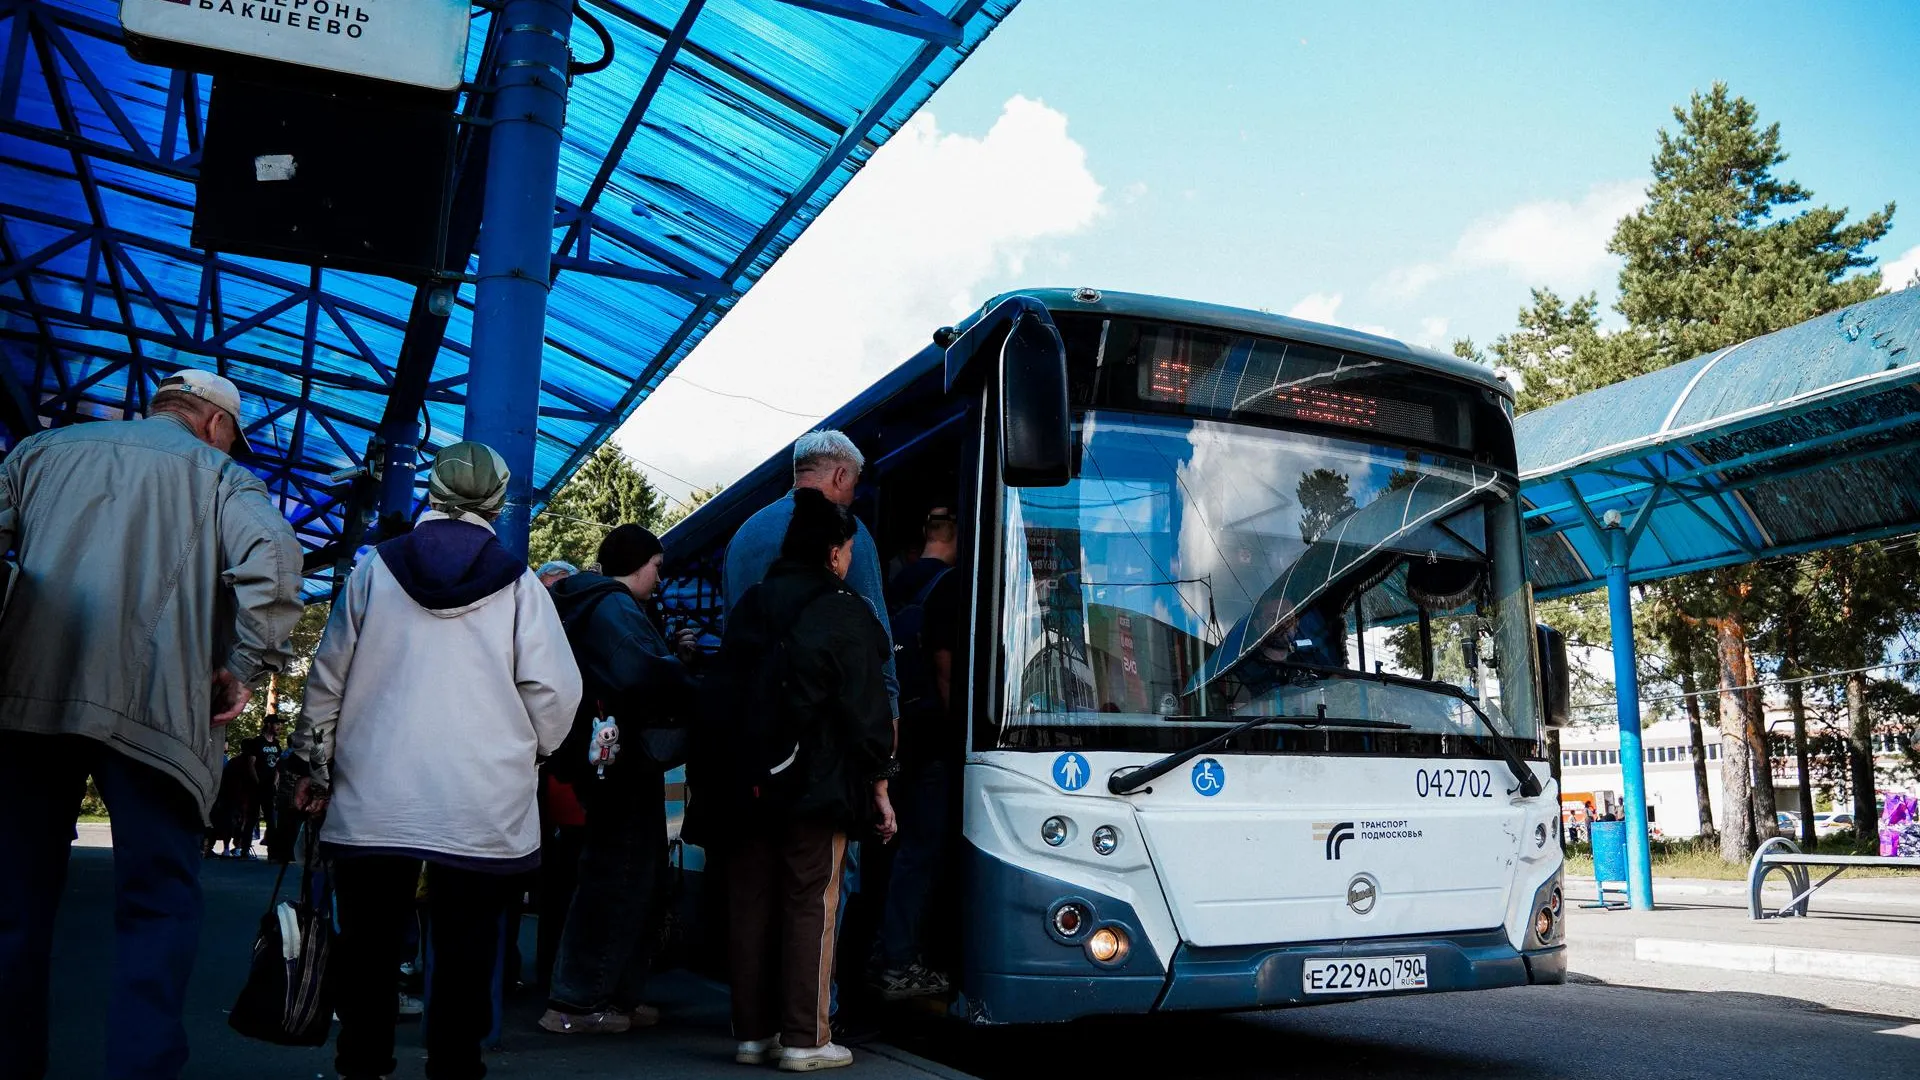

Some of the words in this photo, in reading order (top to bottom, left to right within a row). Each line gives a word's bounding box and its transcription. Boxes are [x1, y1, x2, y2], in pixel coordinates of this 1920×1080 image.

[199, 0, 362, 38] БАКШЕЕВО
[254, 0, 370, 22] РОНЬ
[1416, 768, 1493, 798] 042702
[1360, 820, 1408, 829] ТРАНСПОРТ
[1361, 830, 1423, 840] ПОДМОСКОВЬЯ
[1395, 958, 1421, 979] 790
[1401, 978, 1415, 986] RUS
